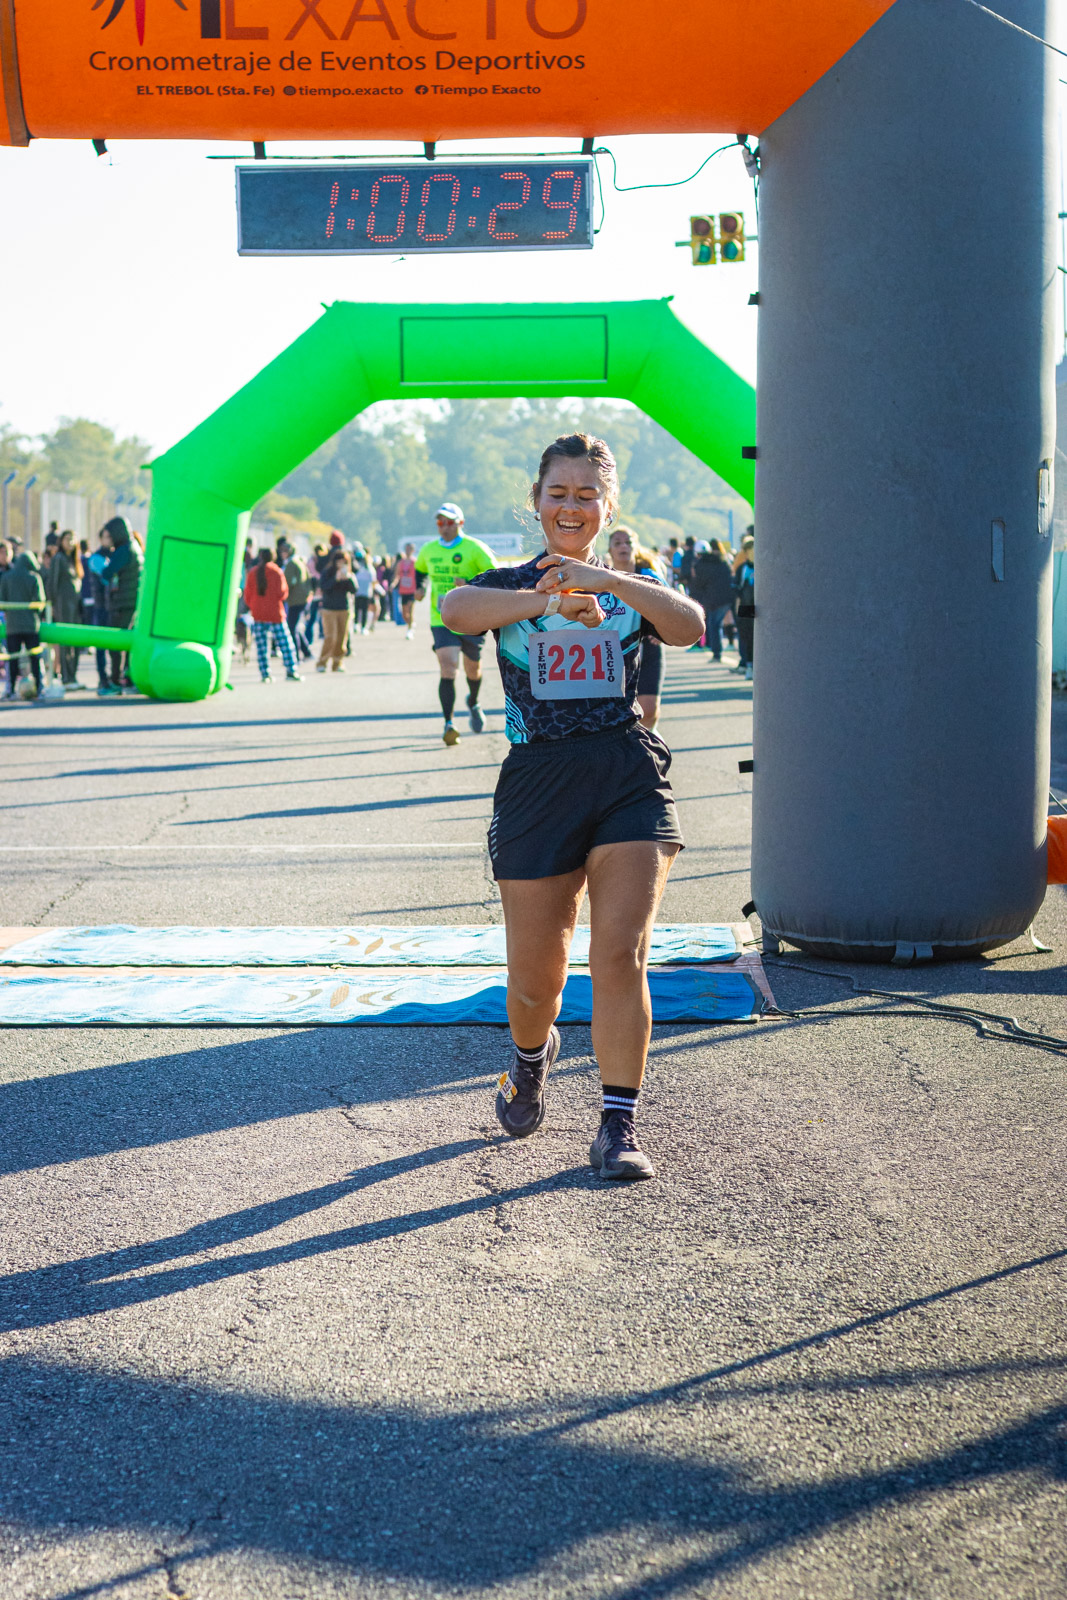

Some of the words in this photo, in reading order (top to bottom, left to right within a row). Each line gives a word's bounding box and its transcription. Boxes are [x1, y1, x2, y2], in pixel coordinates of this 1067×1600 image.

[89, 51, 271, 76] Cronometraje
[278, 51, 312, 71] de
[321, 51, 427, 71] Eventos
[435, 50, 586, 74] Deportivos
[136, 86, 153, 96] EL
[156, 86, 214, 96] TREBOL
[217, 85, 250, 97] (Sta.
[253, 85, 275, 97] Fe)
[299, 85, 404, 99] tiempo.exacto
[431, 84, 488, 97] Tiempo
[492, 84, 542, 96] Exacto
[325, 169, 582, 242] 1:00:29
[537, 641, 547, 685] TIEMPO
[547, 643, 606, 682] 221
[604, 640, 615, 683] EXACTO
